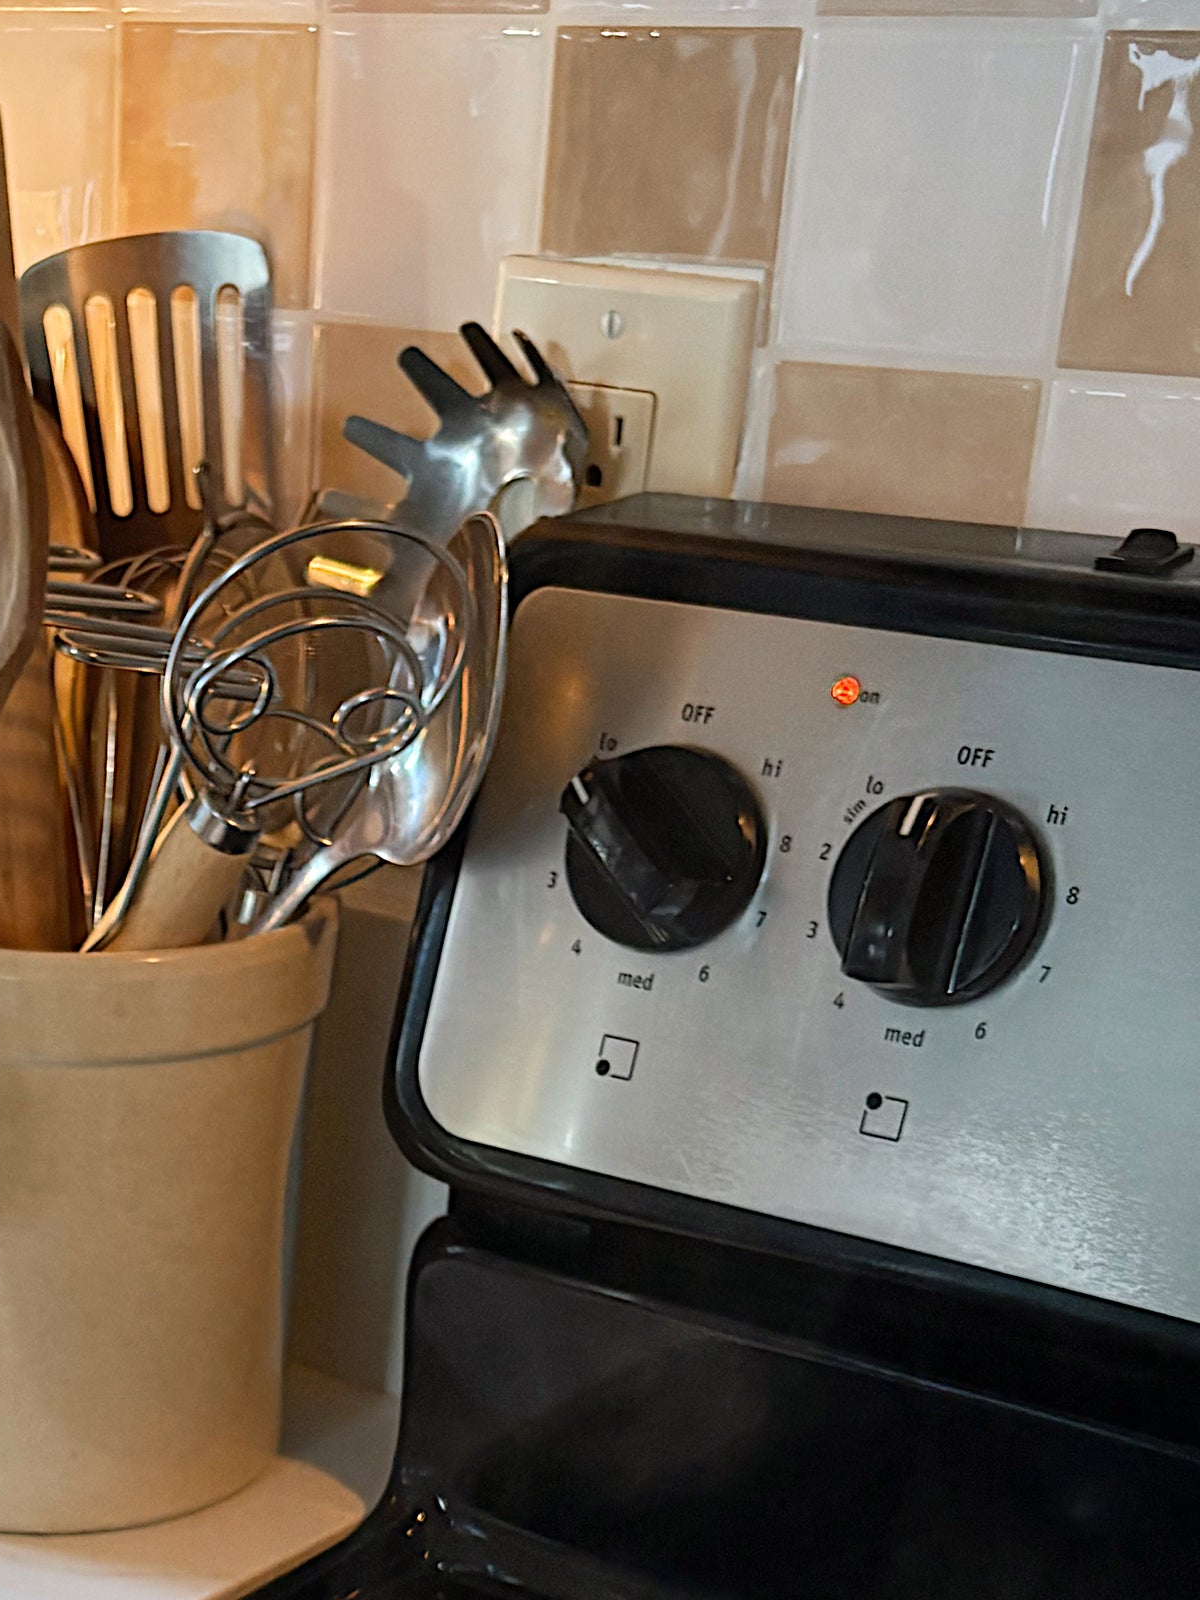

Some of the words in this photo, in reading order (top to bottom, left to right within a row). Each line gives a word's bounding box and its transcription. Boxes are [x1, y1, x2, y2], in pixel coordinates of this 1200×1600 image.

[859, 689, 881, 704] on
[681, 703, 715, 725] OFF
[599, 732, 618, 752] lo
[956, 746, 996, 768] OFF
[761, 757, 784, 778] hi
[865, 775, 885, 796] lo
[842, 797, 867, 825] sim
[1046, 804, 1069, 827] hi
[779, 835, 793, 853] 8
[818, 843, 833, 861] 2
[547, 870, 558, 889] 3
[1065, 886, 1081, 906] 8
[755, 910, 768, 929] 7
[806, 920, 819, 939] 3
[570, 938, 582, 957] 4
[616, 970, 656, 992] med
[698, 964, 710, 984] 6
[1038, 964, 1053, 985] 7
[832, 991, 846, 1010] 4
[884, 1024, 926, 1049] med
[974, 1021, 988, 1041] 6
